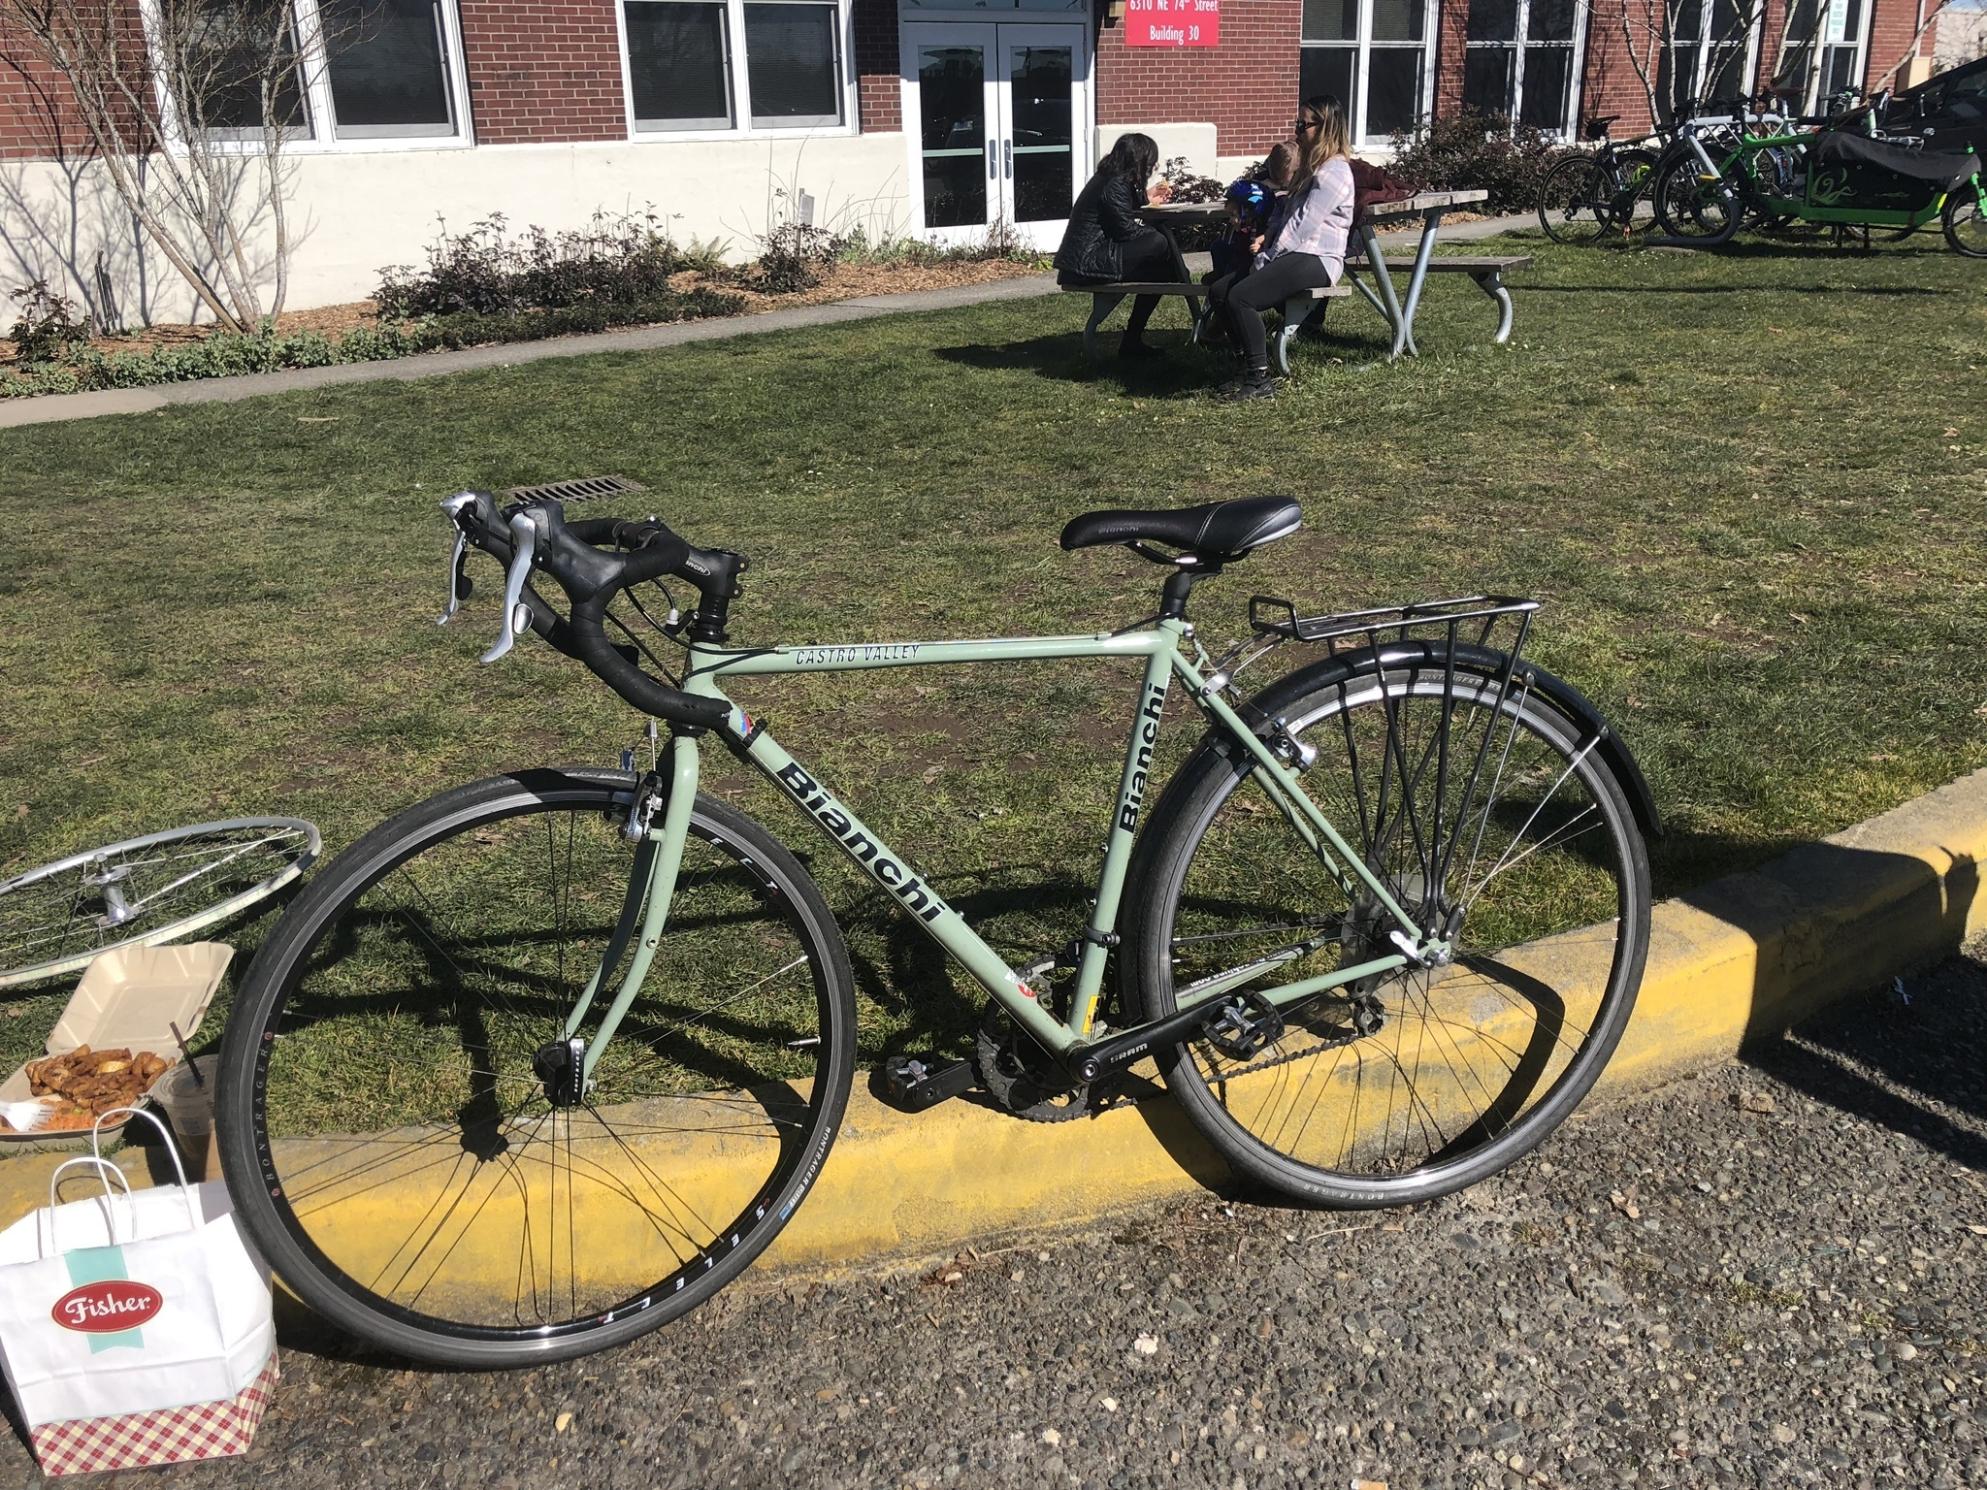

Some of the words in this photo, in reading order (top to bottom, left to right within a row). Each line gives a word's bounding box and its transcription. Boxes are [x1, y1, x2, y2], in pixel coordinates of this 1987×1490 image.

[1157, 0, 1169, 11] NE
[1194, 0, 1218, 12] Street
[1149, 25, 1184, 46] Building
[1188, 25, 1200, 41] 30
[796, 647, 857, 665] CASTRO
[863, 645, 920, 661] VALLEY
[1119, 683, 1166, 834] Bianchi
[775, 762, 946, 923] Bianchi
[256, 1048, 275, 1182] BONTRAGER
[803, 1126, 832, 1187] BONTRAGER
[65, 1293, 152, 1324] Fisher
